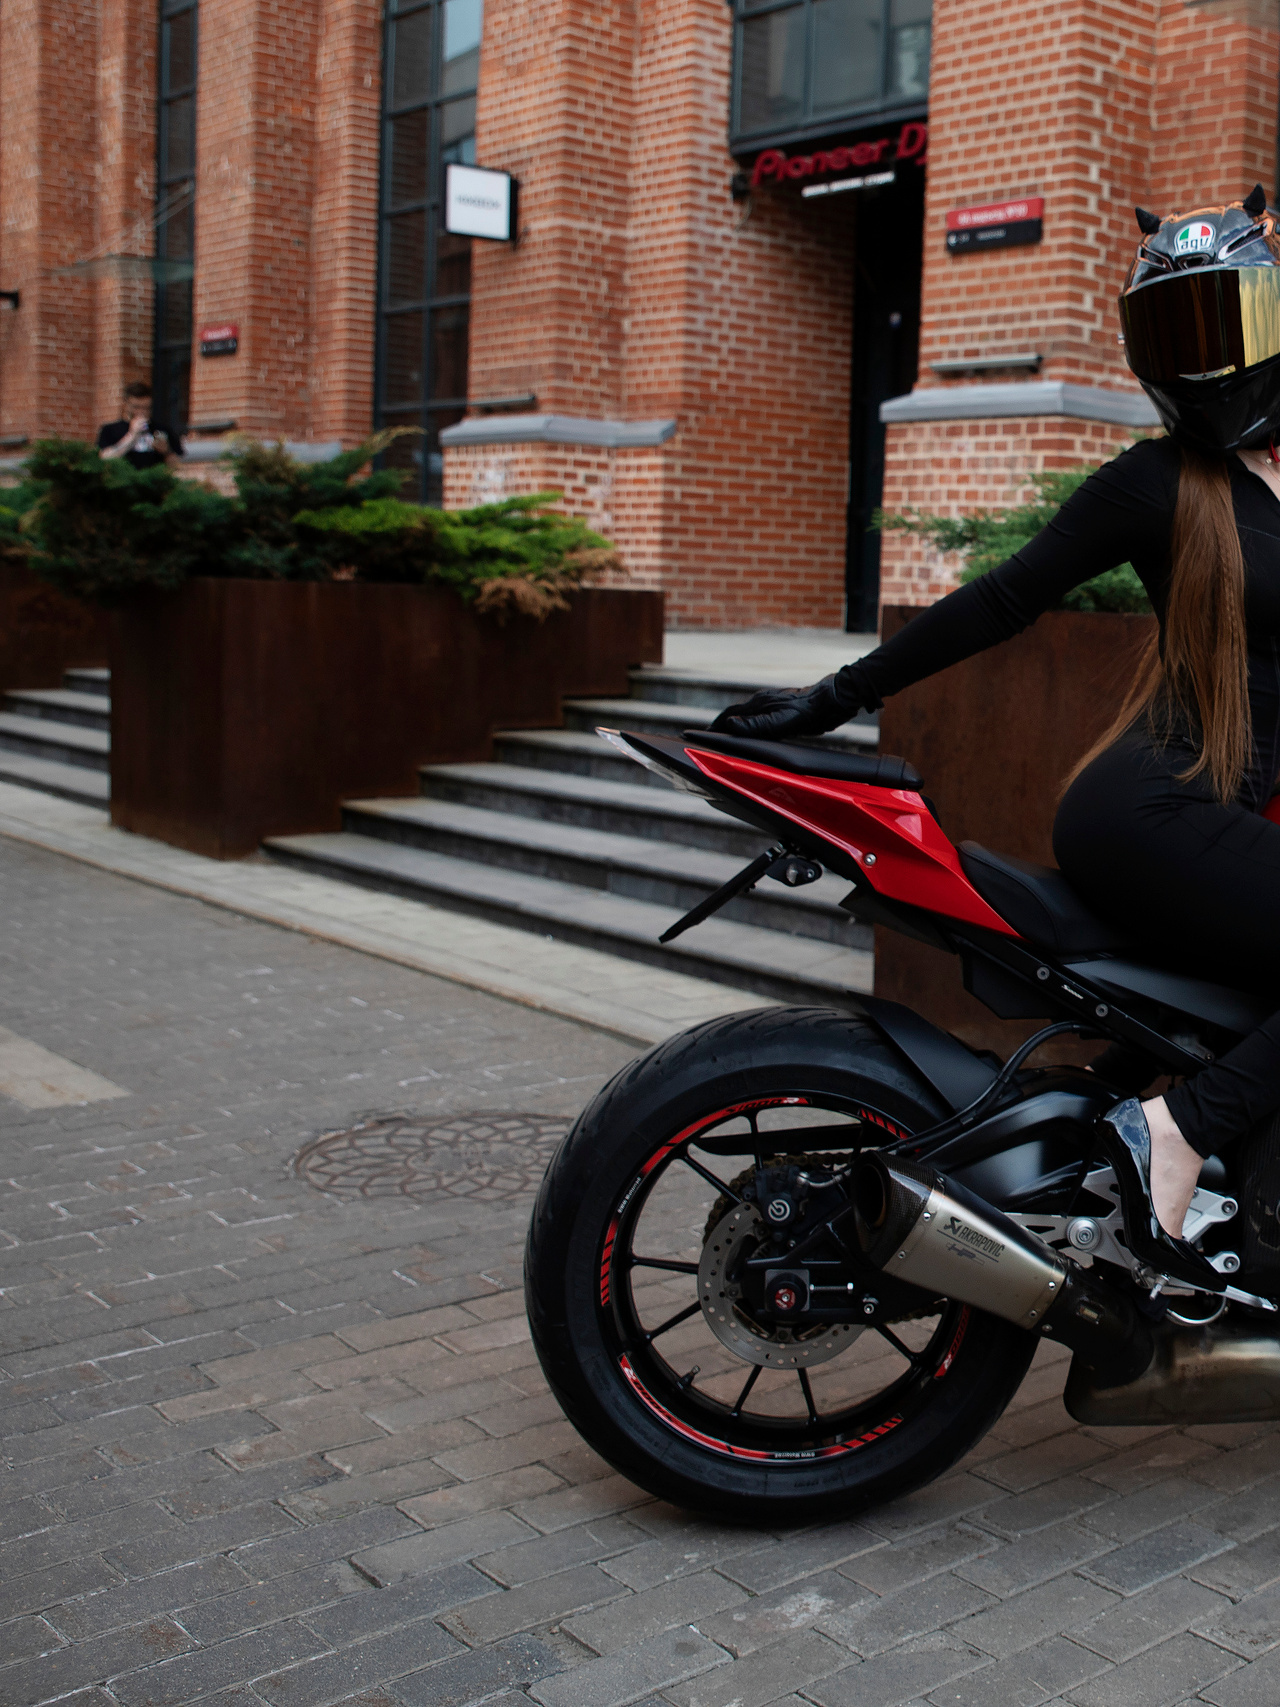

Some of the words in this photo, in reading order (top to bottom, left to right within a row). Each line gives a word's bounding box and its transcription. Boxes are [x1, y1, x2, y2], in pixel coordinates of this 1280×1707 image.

[751, 148, 890, 187] Pioneer
[896, 122, 928, 166] D
[1181, 237, 1210, 250] agv
